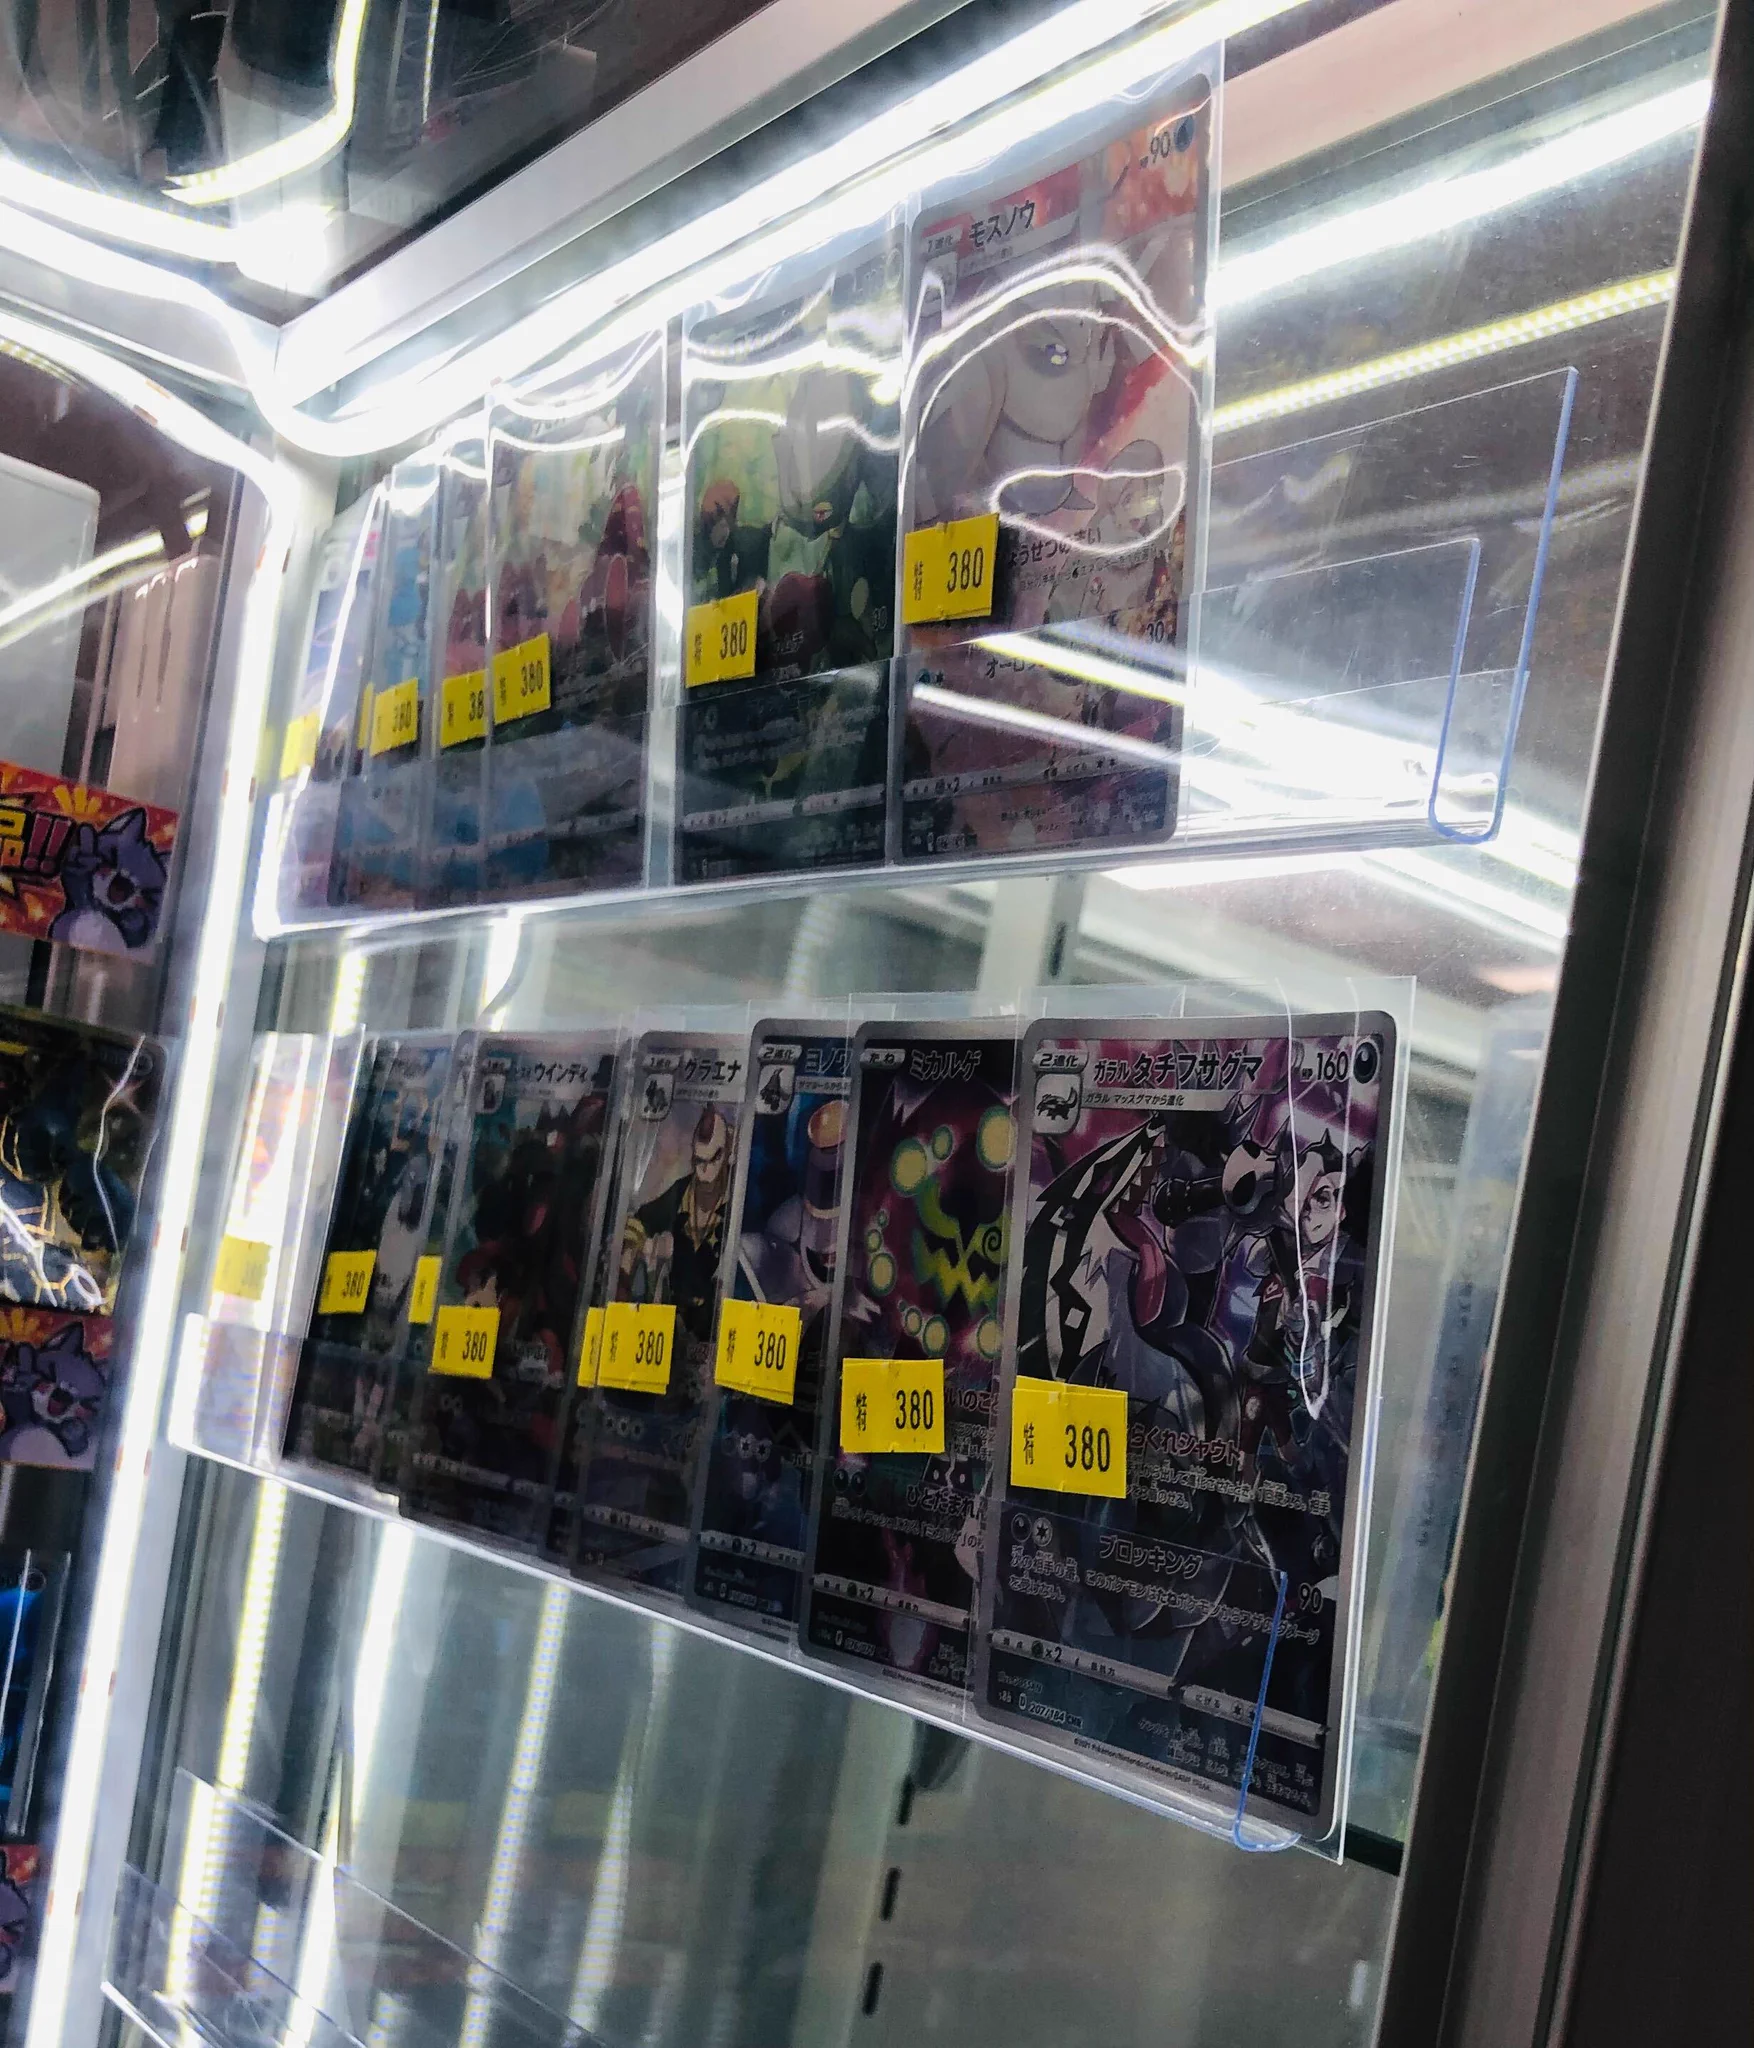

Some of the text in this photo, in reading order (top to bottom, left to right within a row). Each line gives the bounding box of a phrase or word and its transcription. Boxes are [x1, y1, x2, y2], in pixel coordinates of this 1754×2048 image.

[1149, 131, 1172, 164] 90
[968, 199, 1036, 249] モスノウ
[946, 546, 984, 594] 380
[720, 620, 748, 660] 380
[520, 658, 543, 697] 380
[391, 698, 412, 732] 380
[684, 1058, 742, 1083] グラエナ
[763, 1048, 794, 1060] 2進化
[869, 1051, 895, 1065] たね
[909, 1049, 982, 1082] ミカルゲ
[1038, 1052, 1079, 1069] 2進化
[1093, 1051, 1263, 1084] ガラル タチフサグマ
[1315, 1051, 1350, 1083] 160
[534, 1061, 589, 1083] ウインディ
[341, 1270, 366, 1298] 380
[462, 1331, 488, 1362] 380
[635, 1330, 665, 1366] 380
[754, 1330, 787, 1371] 380
[894, 1388, 935, 1430] 380
[1064, 1424, 1111, 1473] 380
[1100, 1534, 1203, 1579] ブロッキング
[1299, 1582, 1324, 1614] 90
